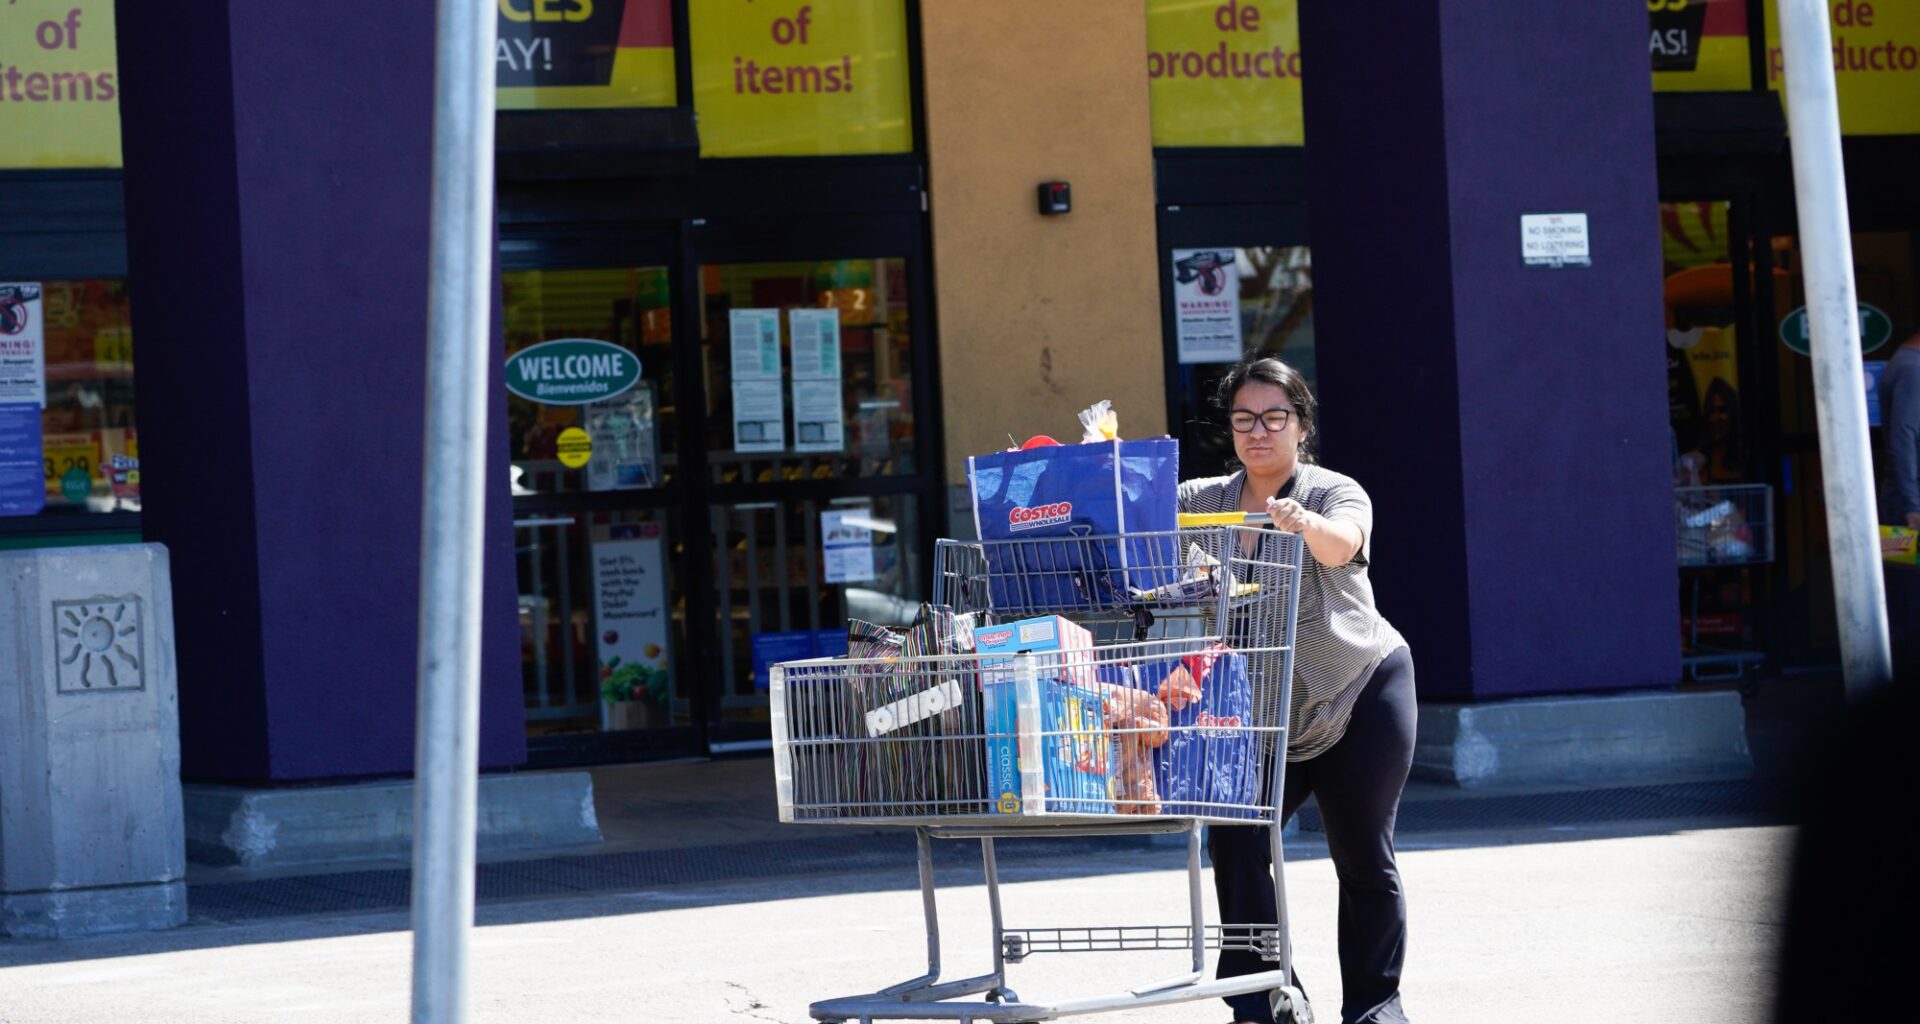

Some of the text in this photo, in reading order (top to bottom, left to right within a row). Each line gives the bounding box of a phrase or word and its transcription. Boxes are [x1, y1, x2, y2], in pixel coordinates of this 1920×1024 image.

[771, 5, 812, 45] of
[1215, 0, 1260, 32] de
[1834, 0, 1873, 27] de
[36, 8, 82, 50] of
[1648, 28, 1688, 56] AS!
[496, 37, 552, 71] AY!
[1769, 37, 1918, 82] pducto
[733, 55, 854, 94] items!
[853, 289, 866, 310] 2
[1801, 310, 1871, 339] ET
[518, 353, 623, 381] WELCOME
[536, 381, 608, 395] Bienvenidos
[1009, 502, 1072, 524] COSTCO
[1028, 515, 1070, 528] WHOLESALE
